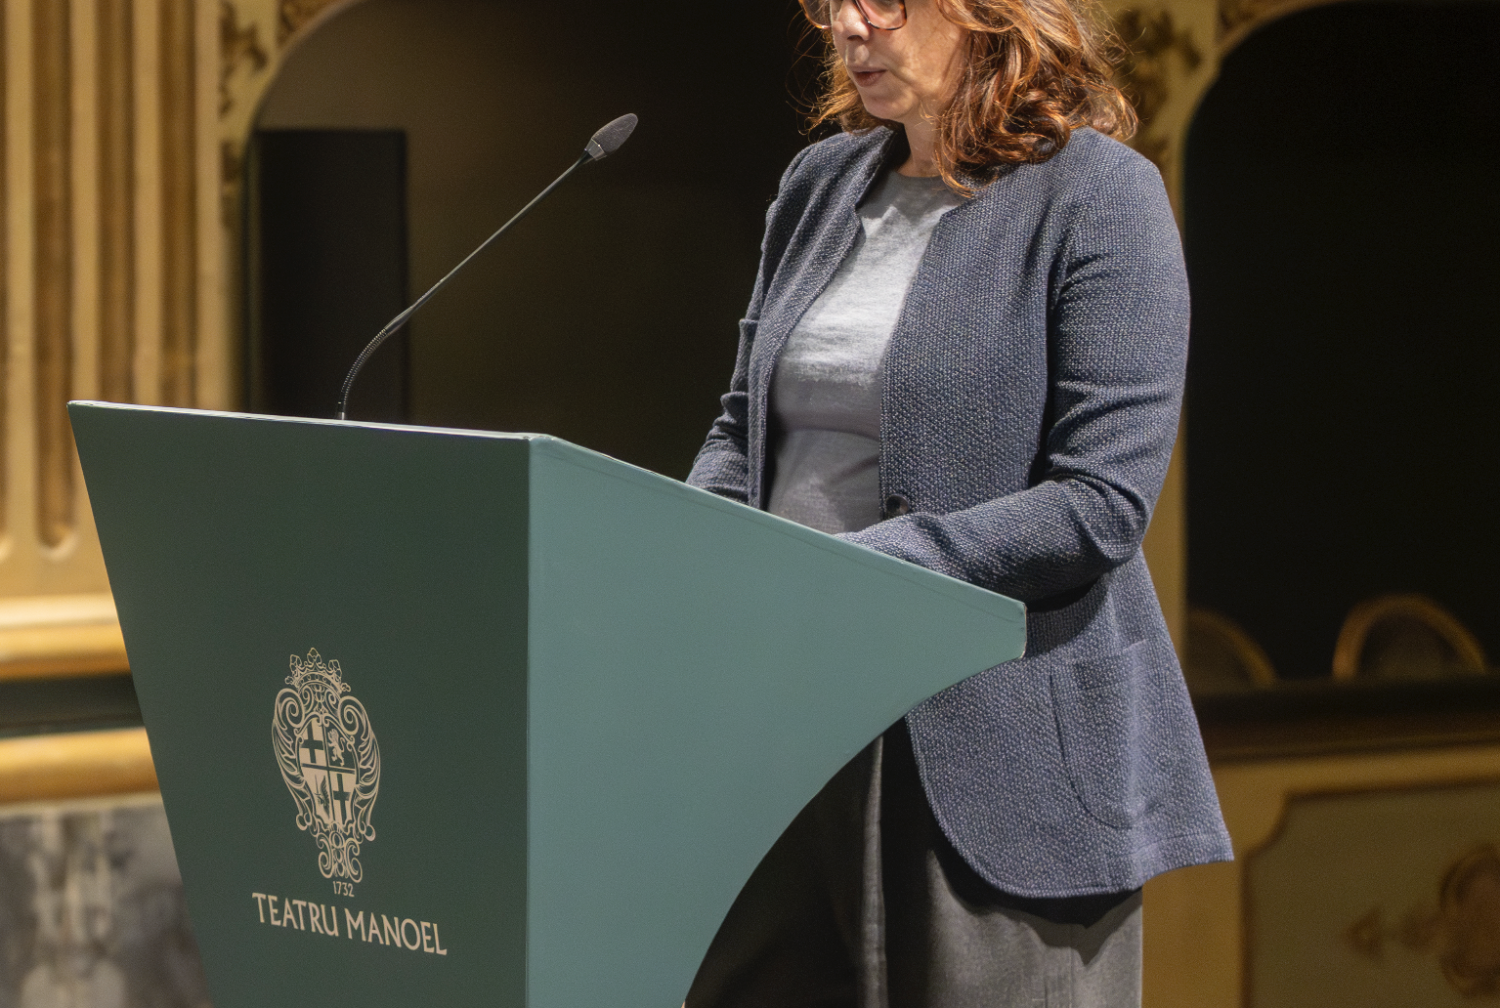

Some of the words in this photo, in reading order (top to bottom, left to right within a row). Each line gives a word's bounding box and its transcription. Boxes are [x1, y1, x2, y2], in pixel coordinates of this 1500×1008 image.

[333, 880, 355, 897] 1732
[252, 892, 339, 937] TEATRU
[344, 907, 448, 956] MANOEL
